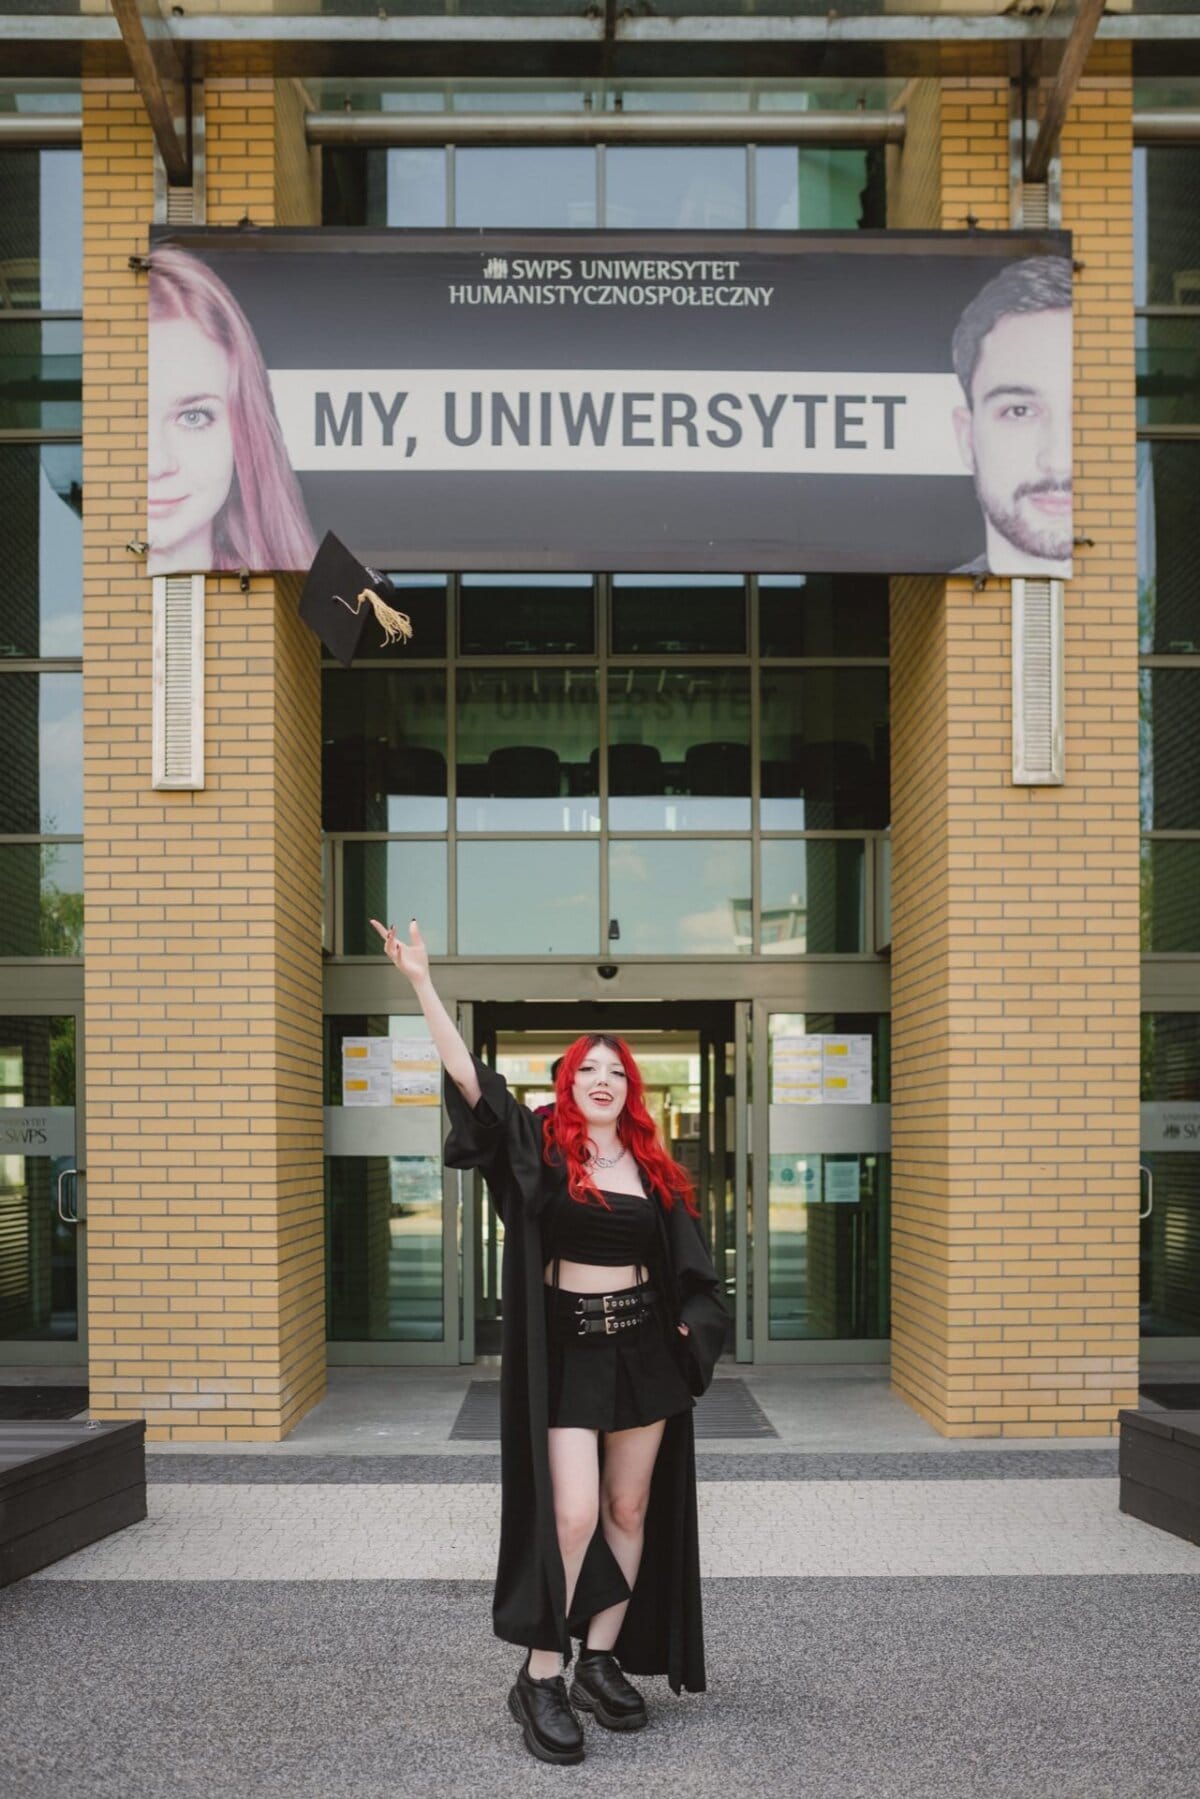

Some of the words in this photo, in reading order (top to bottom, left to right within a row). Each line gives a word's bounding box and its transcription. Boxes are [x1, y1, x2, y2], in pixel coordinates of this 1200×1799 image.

[512, 260, 573, 280] SWPS
[580, 260, 740, 281] UNIWERSYTET
[448, 285, 774, 307] HUMANISTYCZNOSPOŁECZNY
[314, 391, 419, 458] MY,
[444, 391, 907, 451] UNIWERSYTET
